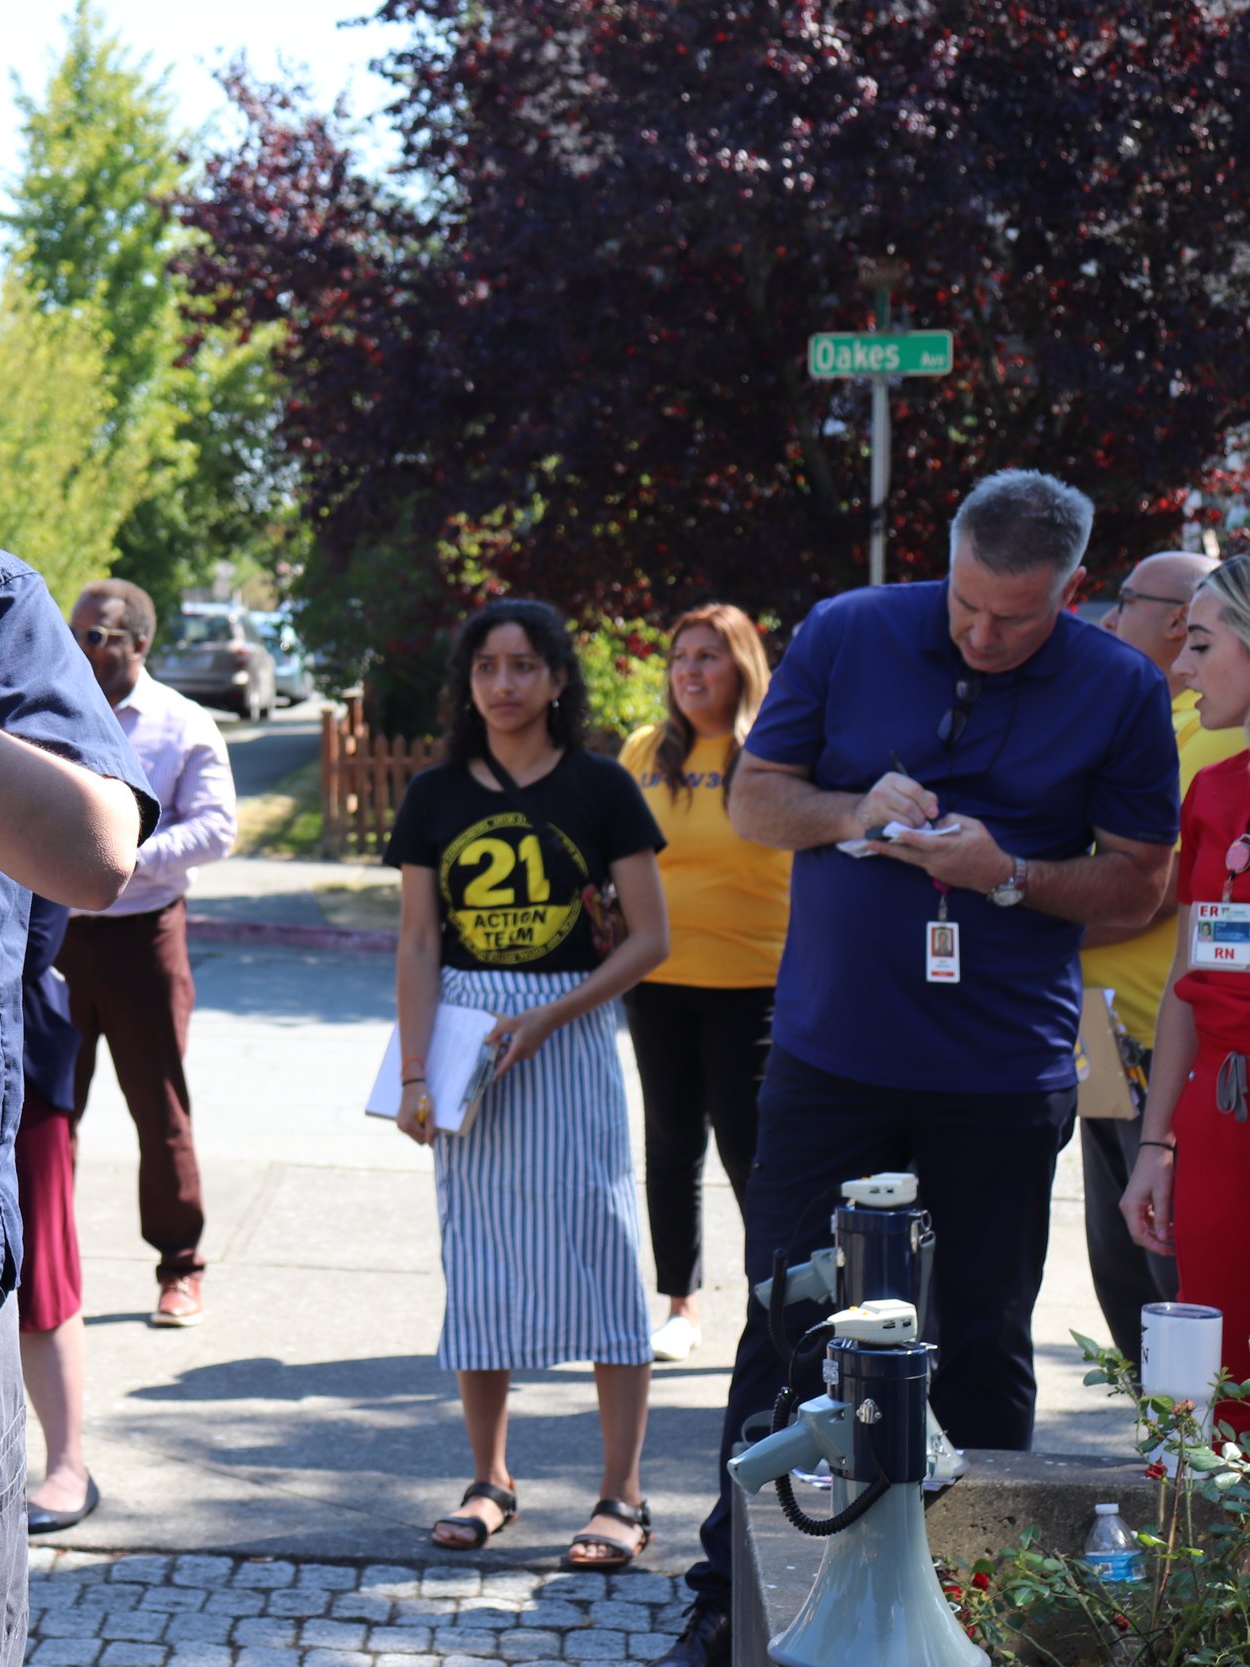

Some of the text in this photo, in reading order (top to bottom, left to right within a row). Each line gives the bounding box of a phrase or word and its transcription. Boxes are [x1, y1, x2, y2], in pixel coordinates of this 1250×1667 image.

[816, 339, 900, 371] Oakes
[458, 834, 551, 907] 21
[474, 909, 548, 929] ACTION
[1200, 905, 1219, 917] ER
[1214, 946, 1235, 960] RN
